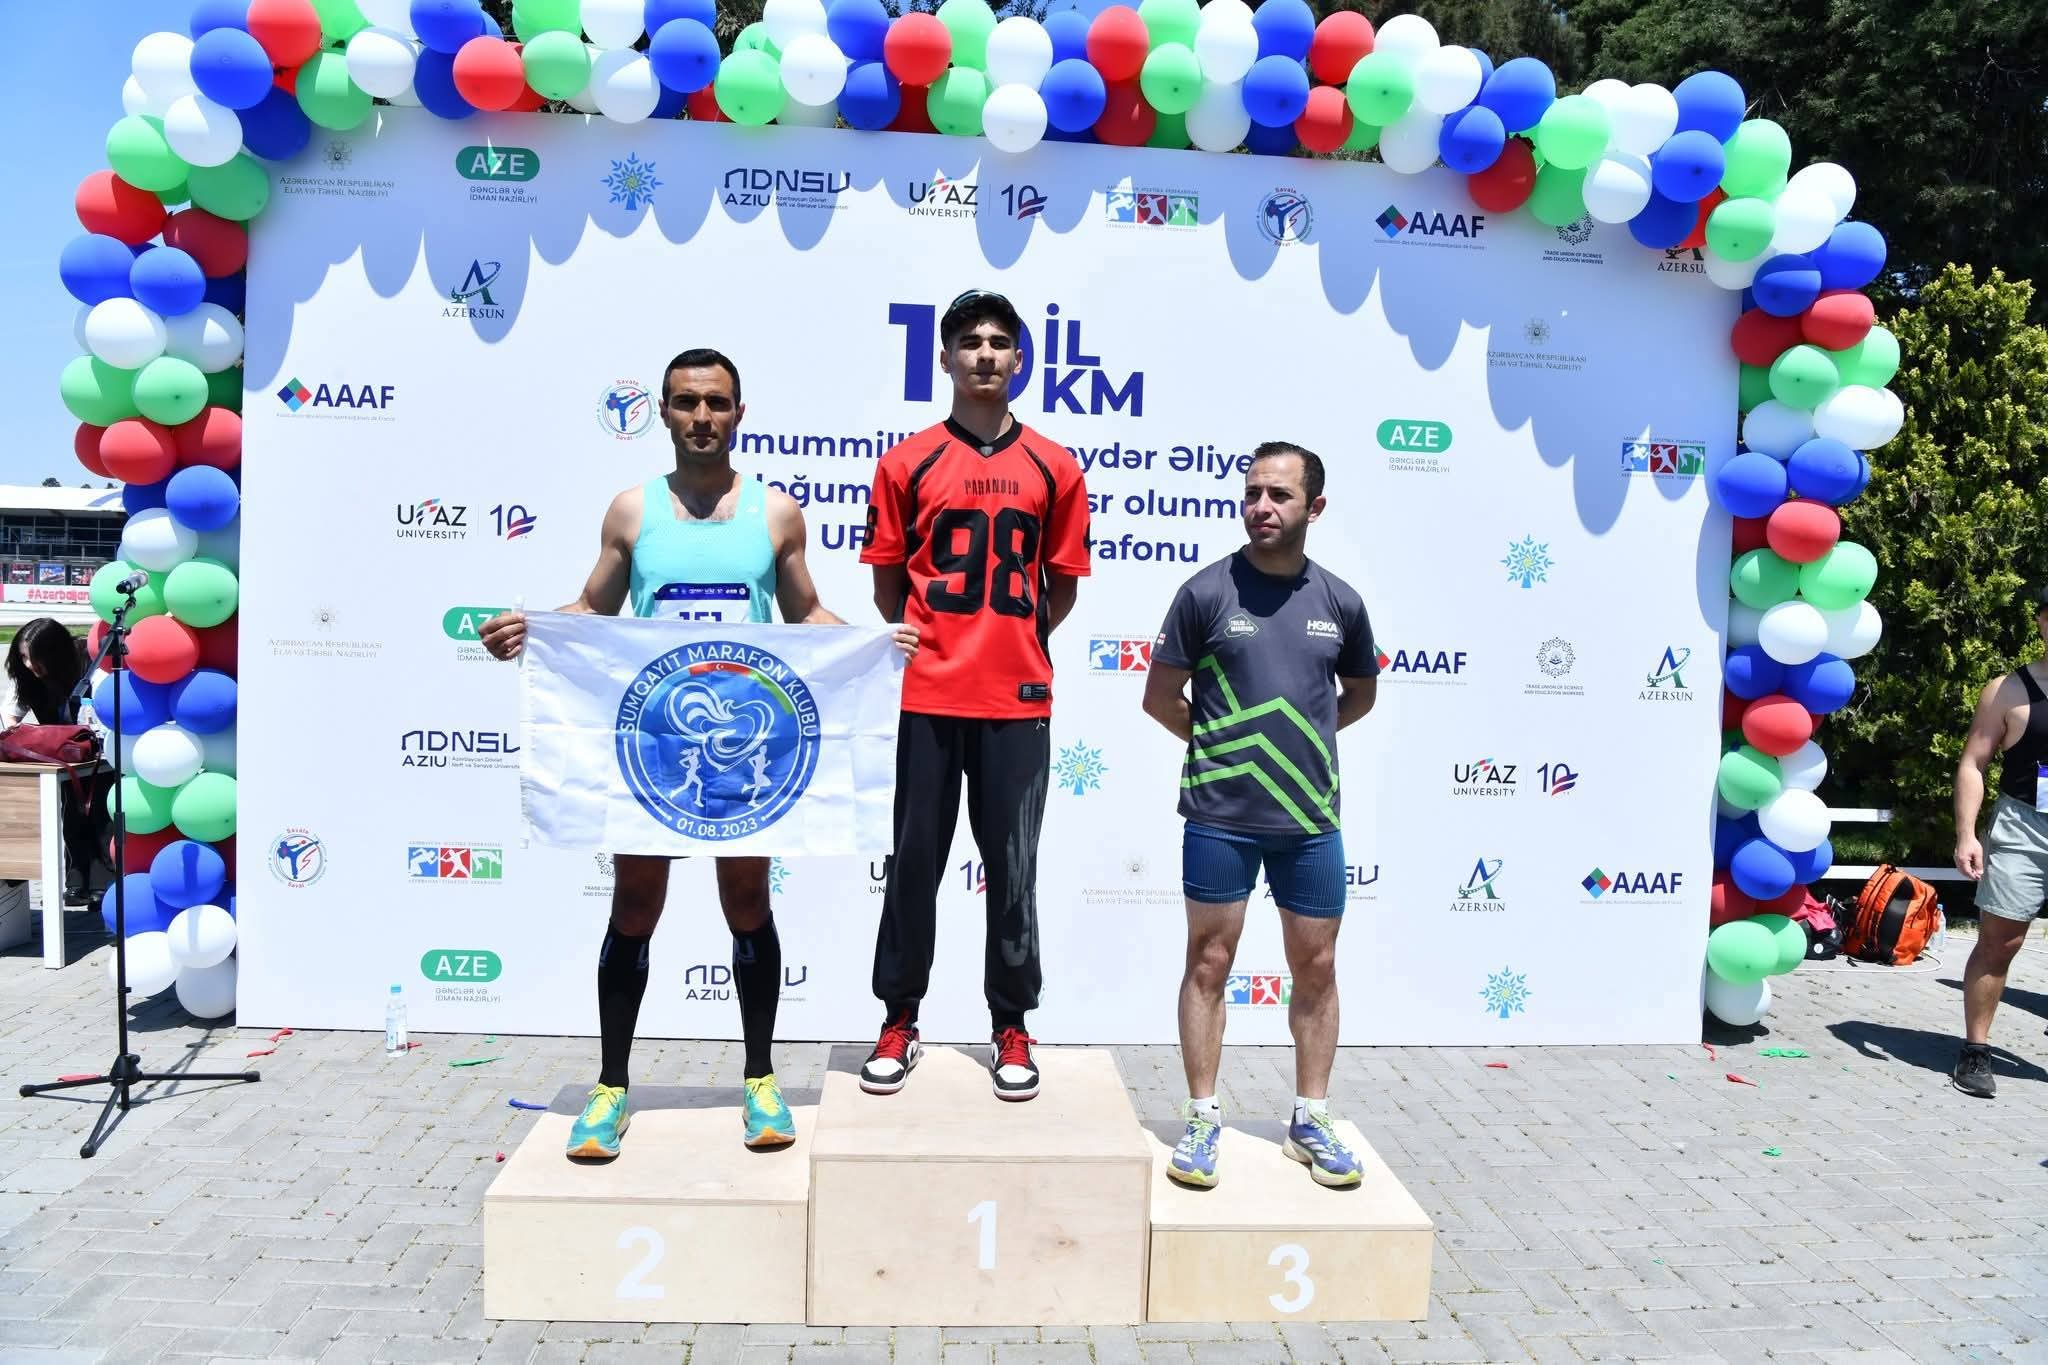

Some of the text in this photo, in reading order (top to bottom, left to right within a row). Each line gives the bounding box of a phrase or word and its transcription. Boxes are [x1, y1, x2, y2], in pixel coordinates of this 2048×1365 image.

[470, 153, 525, 176] AZE
[725, 193, 771, 206] AZIU
[908, 207, 978, 219] UNIVERSITY
[1408, 211, 1485, 238] AAAF
[1657, 260, 1707, 274] AZERSU
[442, 308, 505, 319] AZERSUN
[312, 383, 395, 409] AAAF
[1042, 367, 1144, 418] KM
[1389, 424, 1439, 448] AZE
[728, 430, 1252, 480] mummil ydər Əliye
[757, 473, 1247, 519] ğum sr olunm
[964, 479, 1019, 497] PARANOID
[397, 529, 467, 539] UNIVERSITY
[1089, 535, 1199, 562] rafonu
[925, 507, 1041, 620] 98
[1306, 619, 1339, 634] HOKA
[1391, 650, 1467, 674] AAAF
[619, 644, 818, 737] SUMQAYIT MARAFON KLUBU
[1638, 691, 1694, 701] AZERSUN
[402, 755, 447, 767] AZIU
[1453, 788, 1516, 797] UNIVERSITY
[676, 818, 758, 838] 01.08.2023
[1611, 871, 1683, 894] AAAF
[1449, 902, 1506, 912] AZERSUN
[434, 955, 488, 977] AZE
[685, 988, 730, 1001] AZIU
[967, 1200, 998, 1270] 1
[615, 1226, 666, 1300] 2
[1267, 1243, 1316, 1313] 3
